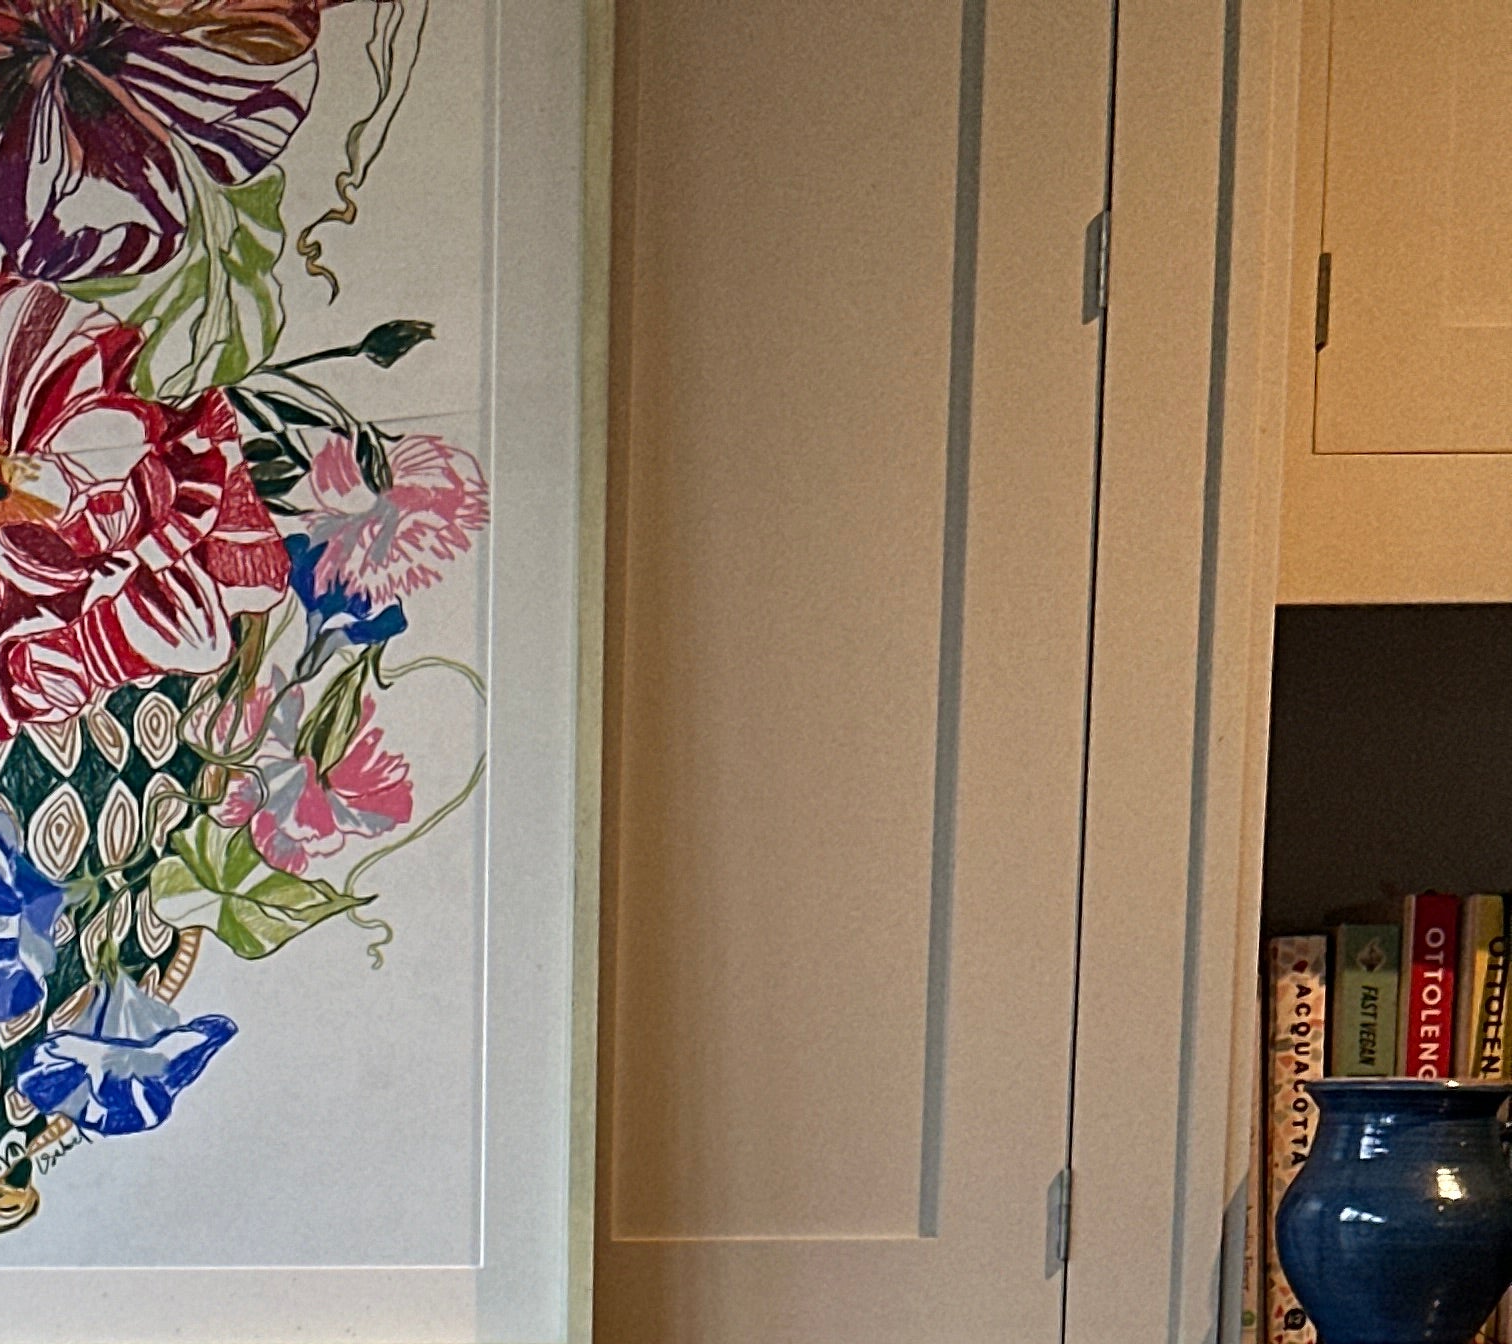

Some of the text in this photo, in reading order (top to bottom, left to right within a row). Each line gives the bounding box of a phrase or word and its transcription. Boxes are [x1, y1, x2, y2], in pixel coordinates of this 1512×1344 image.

[1290, 984, 1313, 1167] ACQUACOTTA
[1359, 985, 1379, 1066] FAST VEGAN
[1480, 935, 1506, 1079] OTTOLEN
